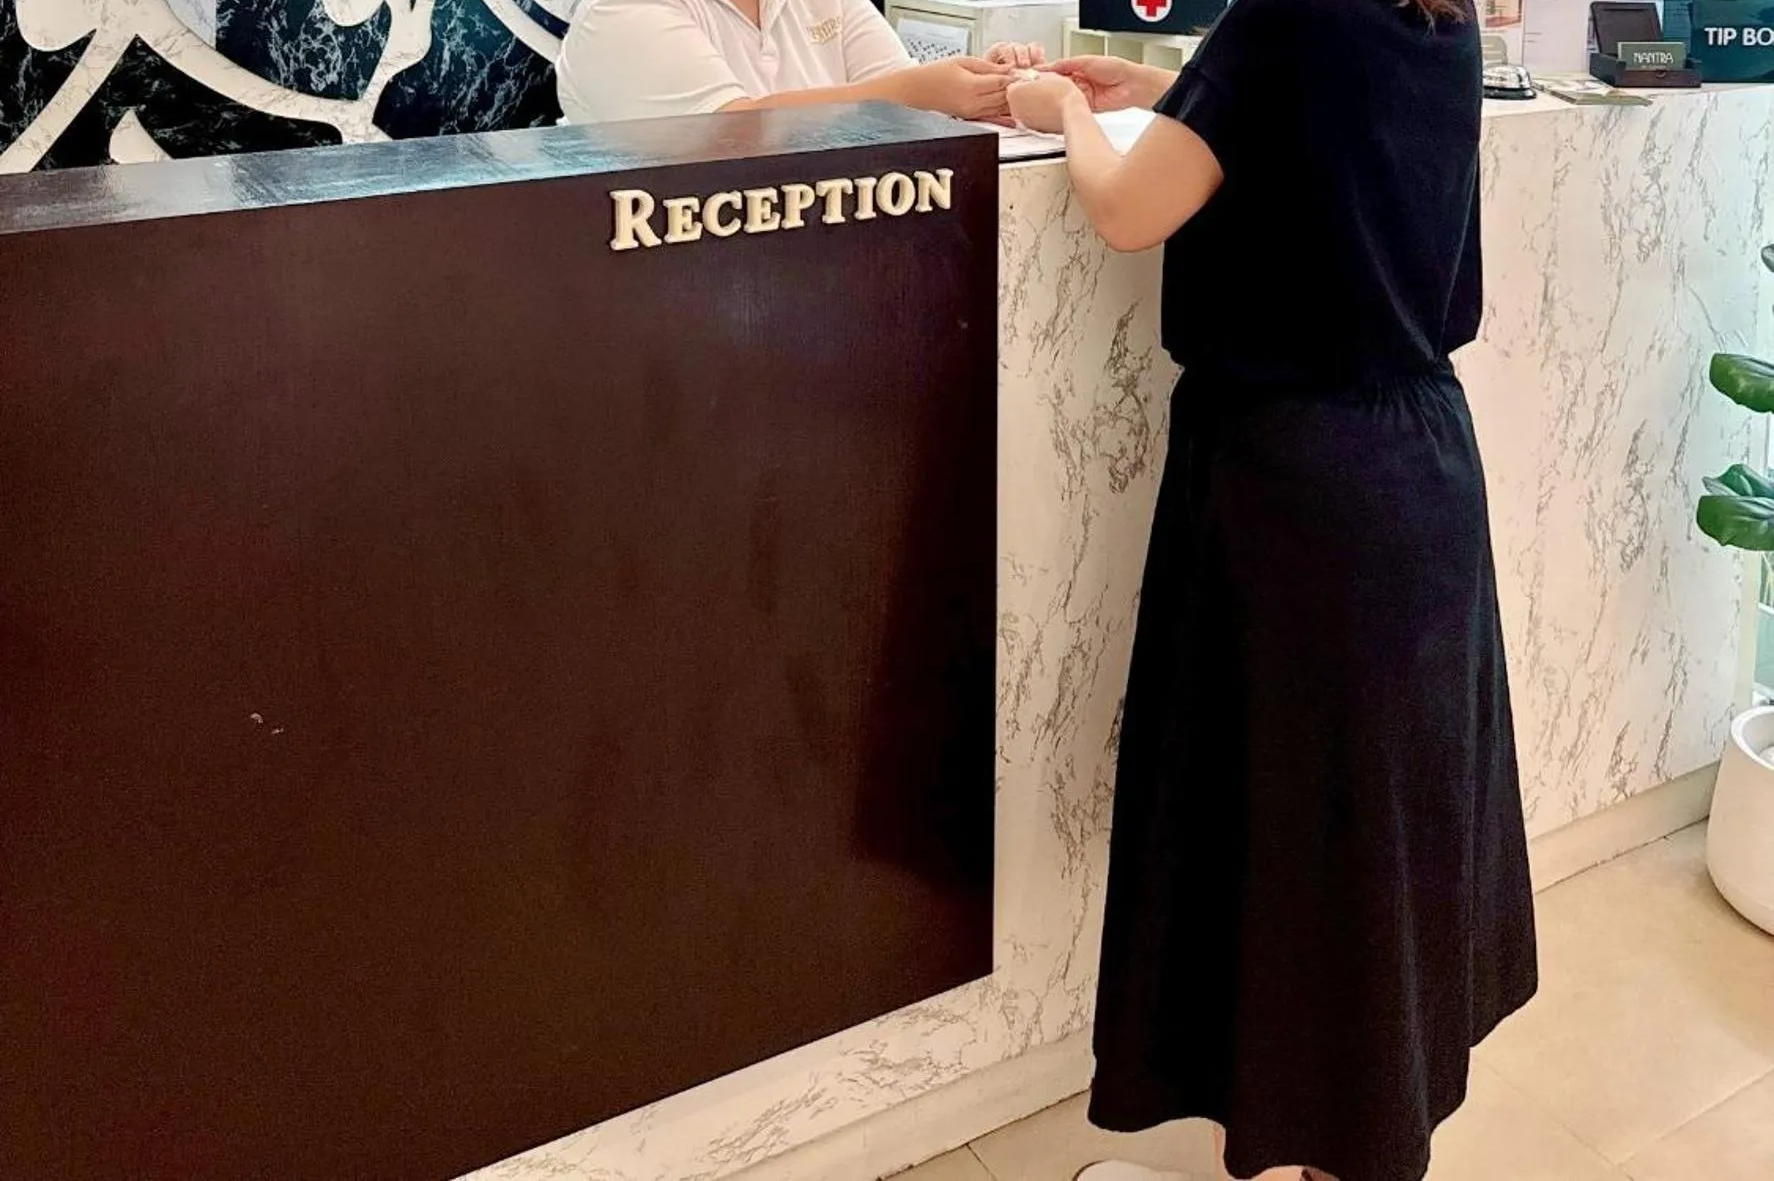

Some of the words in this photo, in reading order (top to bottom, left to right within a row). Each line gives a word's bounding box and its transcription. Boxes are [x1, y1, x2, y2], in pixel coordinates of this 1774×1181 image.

[1703, 27, 1737, 46] TIP
[1742, 27, 1774, 47] BO
[1633, 52, 1674, 64] NANTRA
[608, 167, 954, 251] RECEPTION
